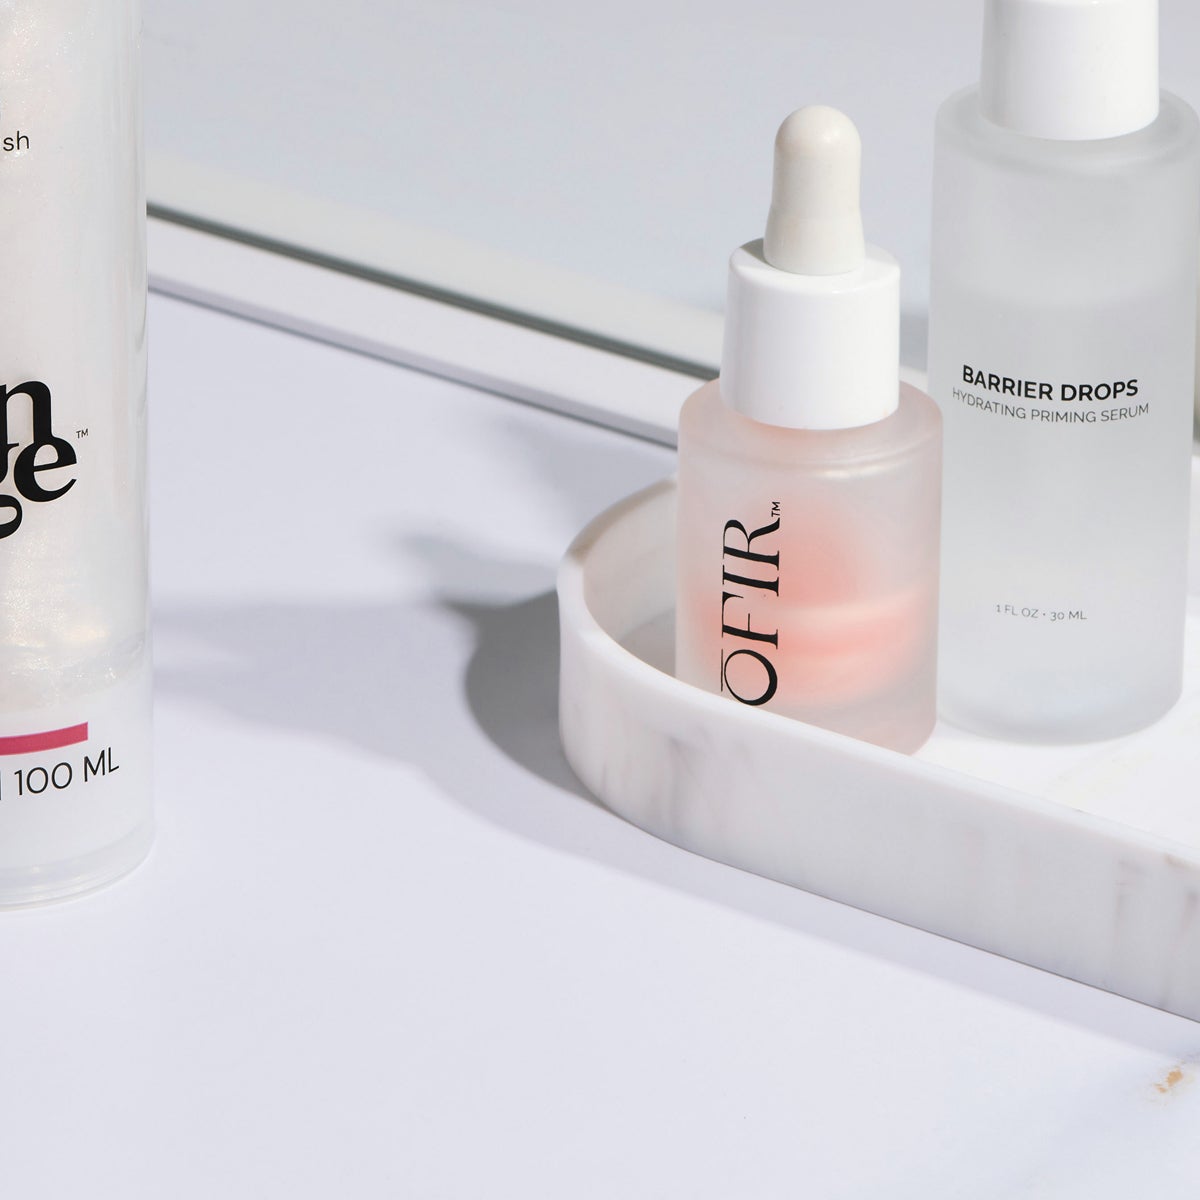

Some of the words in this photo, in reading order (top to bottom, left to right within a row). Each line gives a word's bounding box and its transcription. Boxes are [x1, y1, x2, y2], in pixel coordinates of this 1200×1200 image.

[962, 364, 1053, 401] BARRIER
[1061, 379, 1139, 401] DROPS
[952, 387, 1026, 419] HYDRATING
[1031, 408, 1097, 423] PRIMING
[1100, 402, 1150, 422] SERUM
[996, 604, 1001, 613] 1
[1004, 604, 1018, 616] FL
[1021, 607, 1039, 619] OZ
[1050, 611, 1065, 621] 30
[1068, 610, 1088, 620] ML
[14, 762, 73, 796] 100
[83, 746, 119, 782] ML
